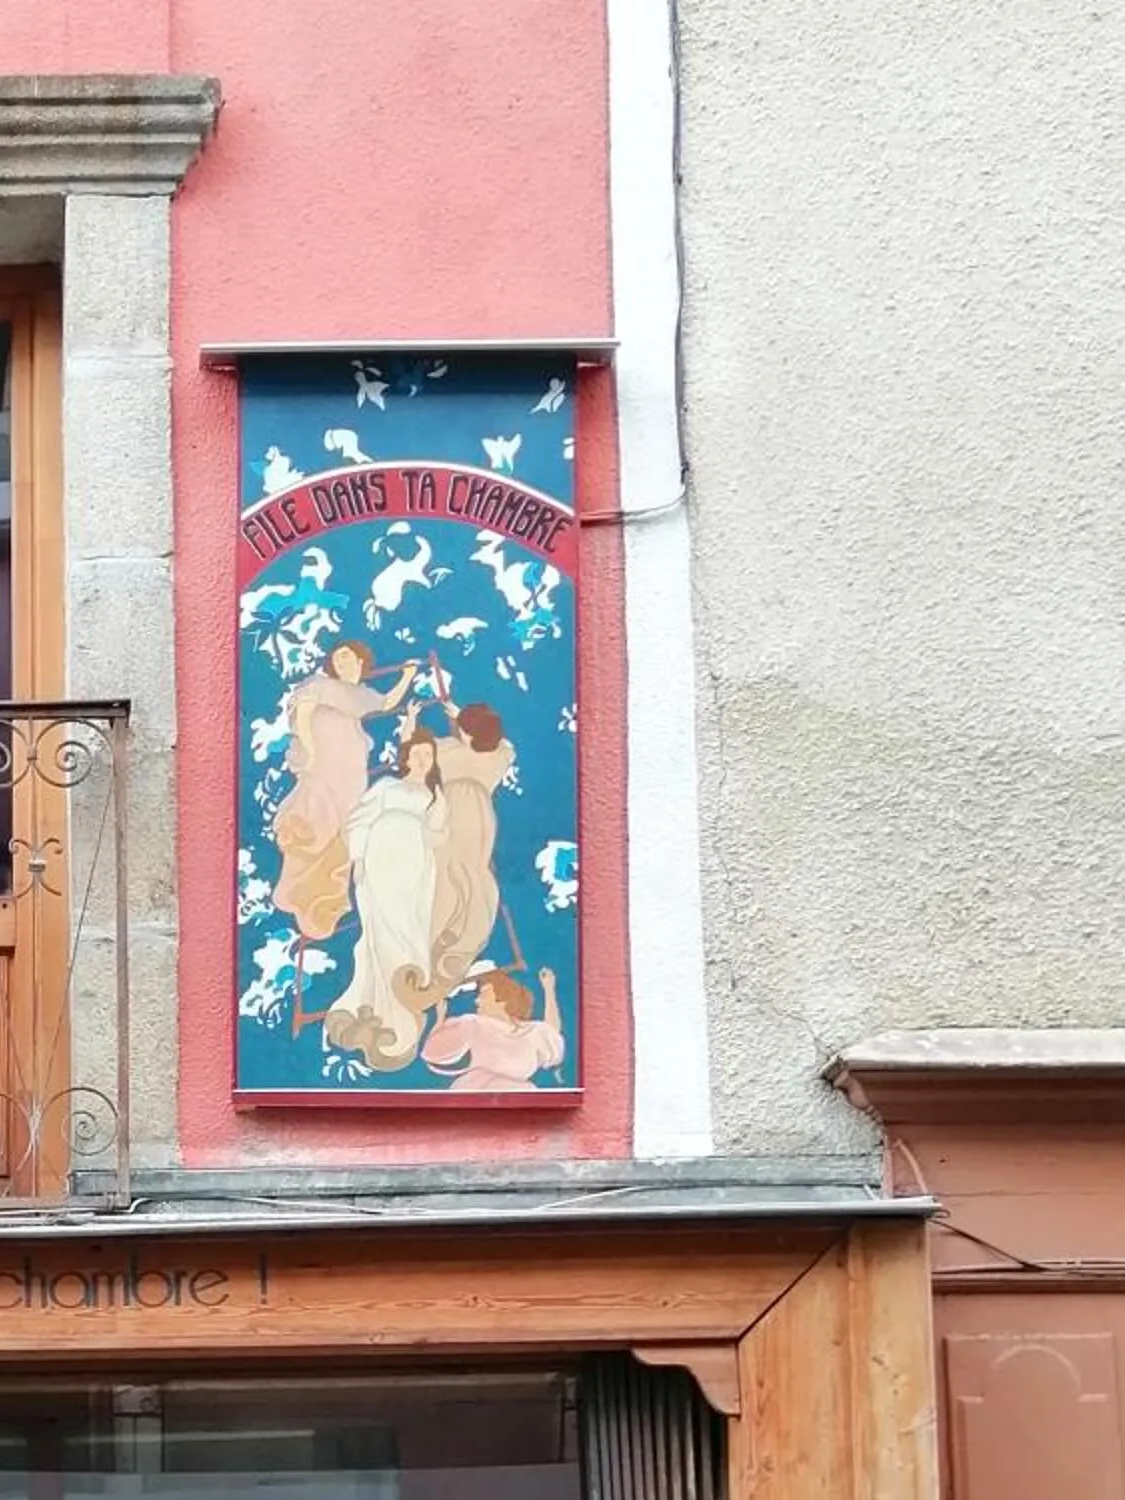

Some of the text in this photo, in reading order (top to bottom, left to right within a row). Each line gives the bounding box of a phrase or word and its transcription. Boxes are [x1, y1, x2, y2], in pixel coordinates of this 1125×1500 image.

[242, 470, 573, 561] FILE DANS TA CHAMBRE
